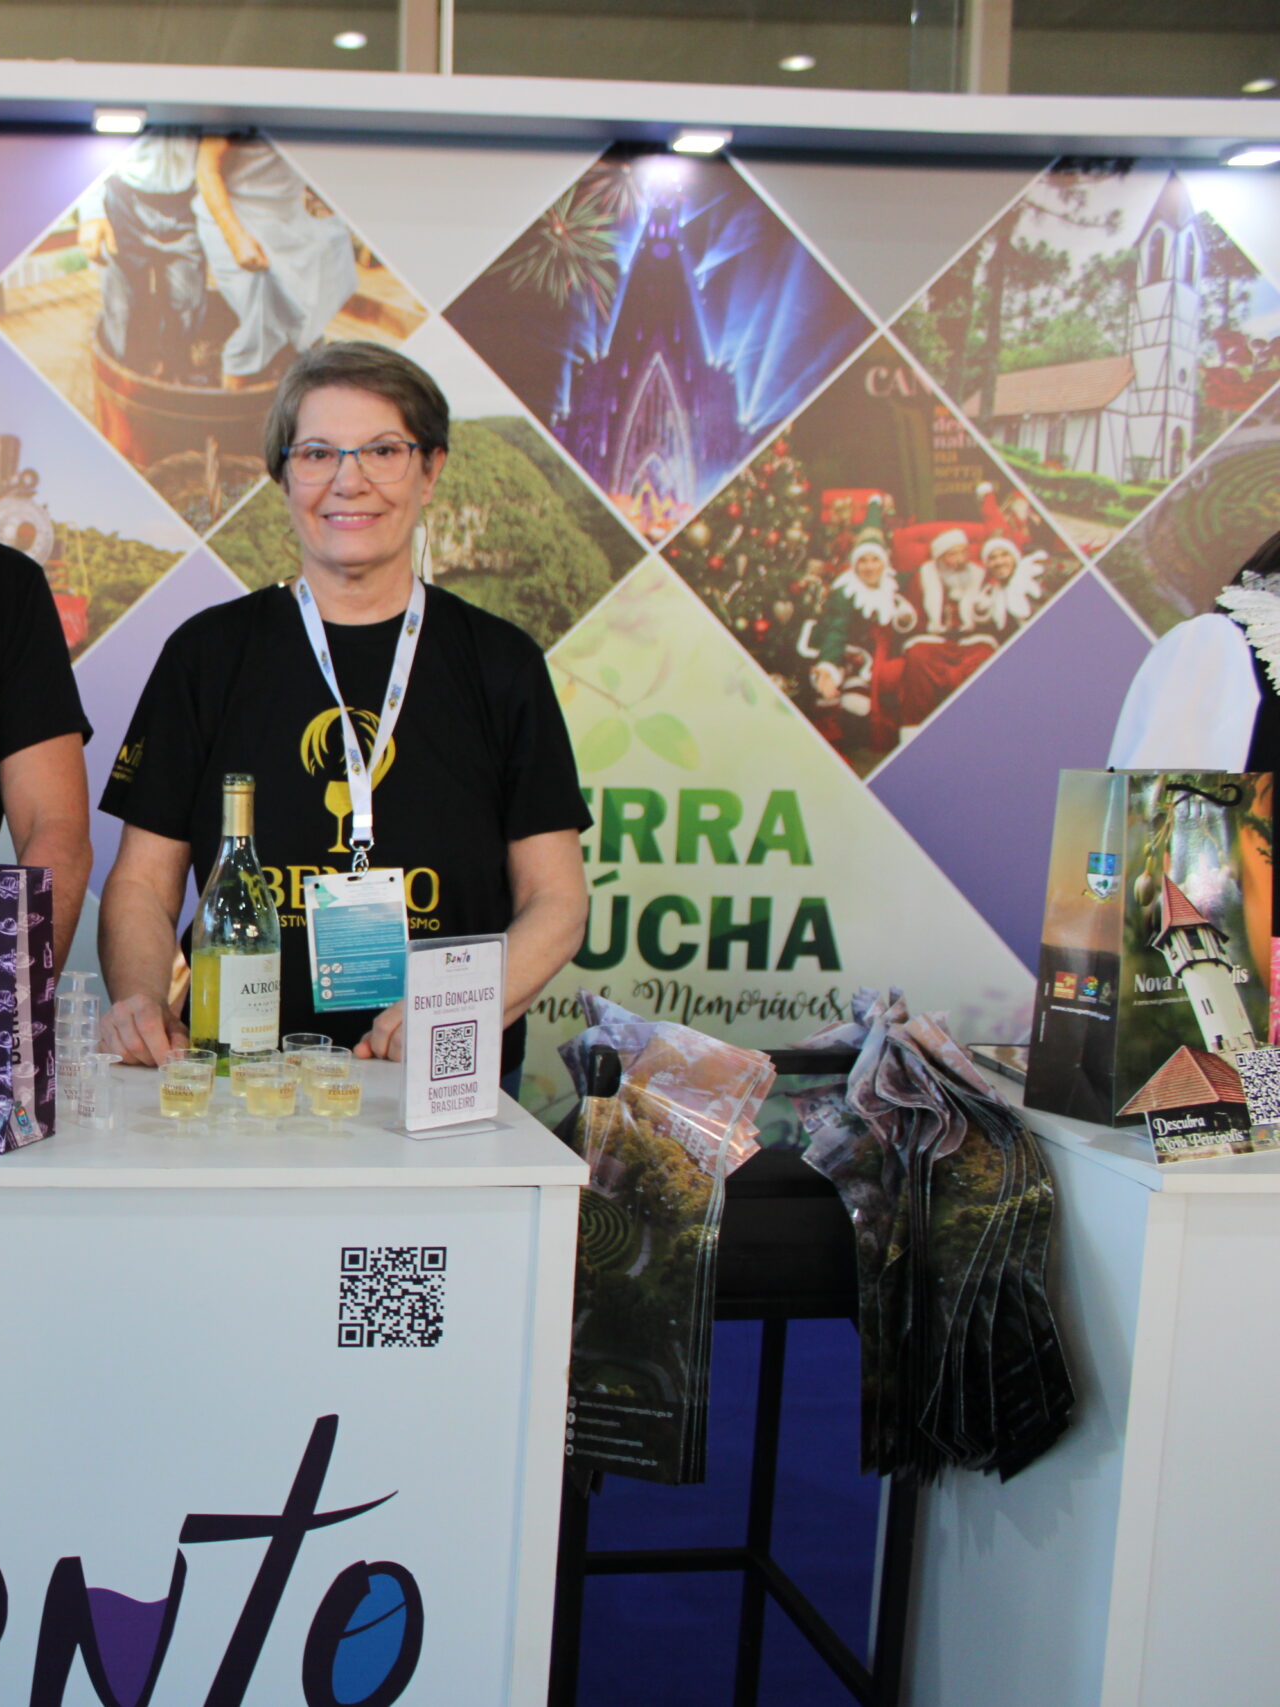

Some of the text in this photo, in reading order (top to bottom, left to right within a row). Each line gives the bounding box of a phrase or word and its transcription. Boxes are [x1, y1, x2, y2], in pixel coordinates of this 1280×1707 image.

[1134, 973, 1173, 993] Nova
[414, 994, 443, 1011] BENTO
[428, 1081, 478, 1101] ENOTURISMO
[430, 1095, 476, 1114] BRASILEIRO
[1152, 1113, 1206, 1136] Descubra
[1156, 1128, 1245, 1152] Nova Petrópolis
